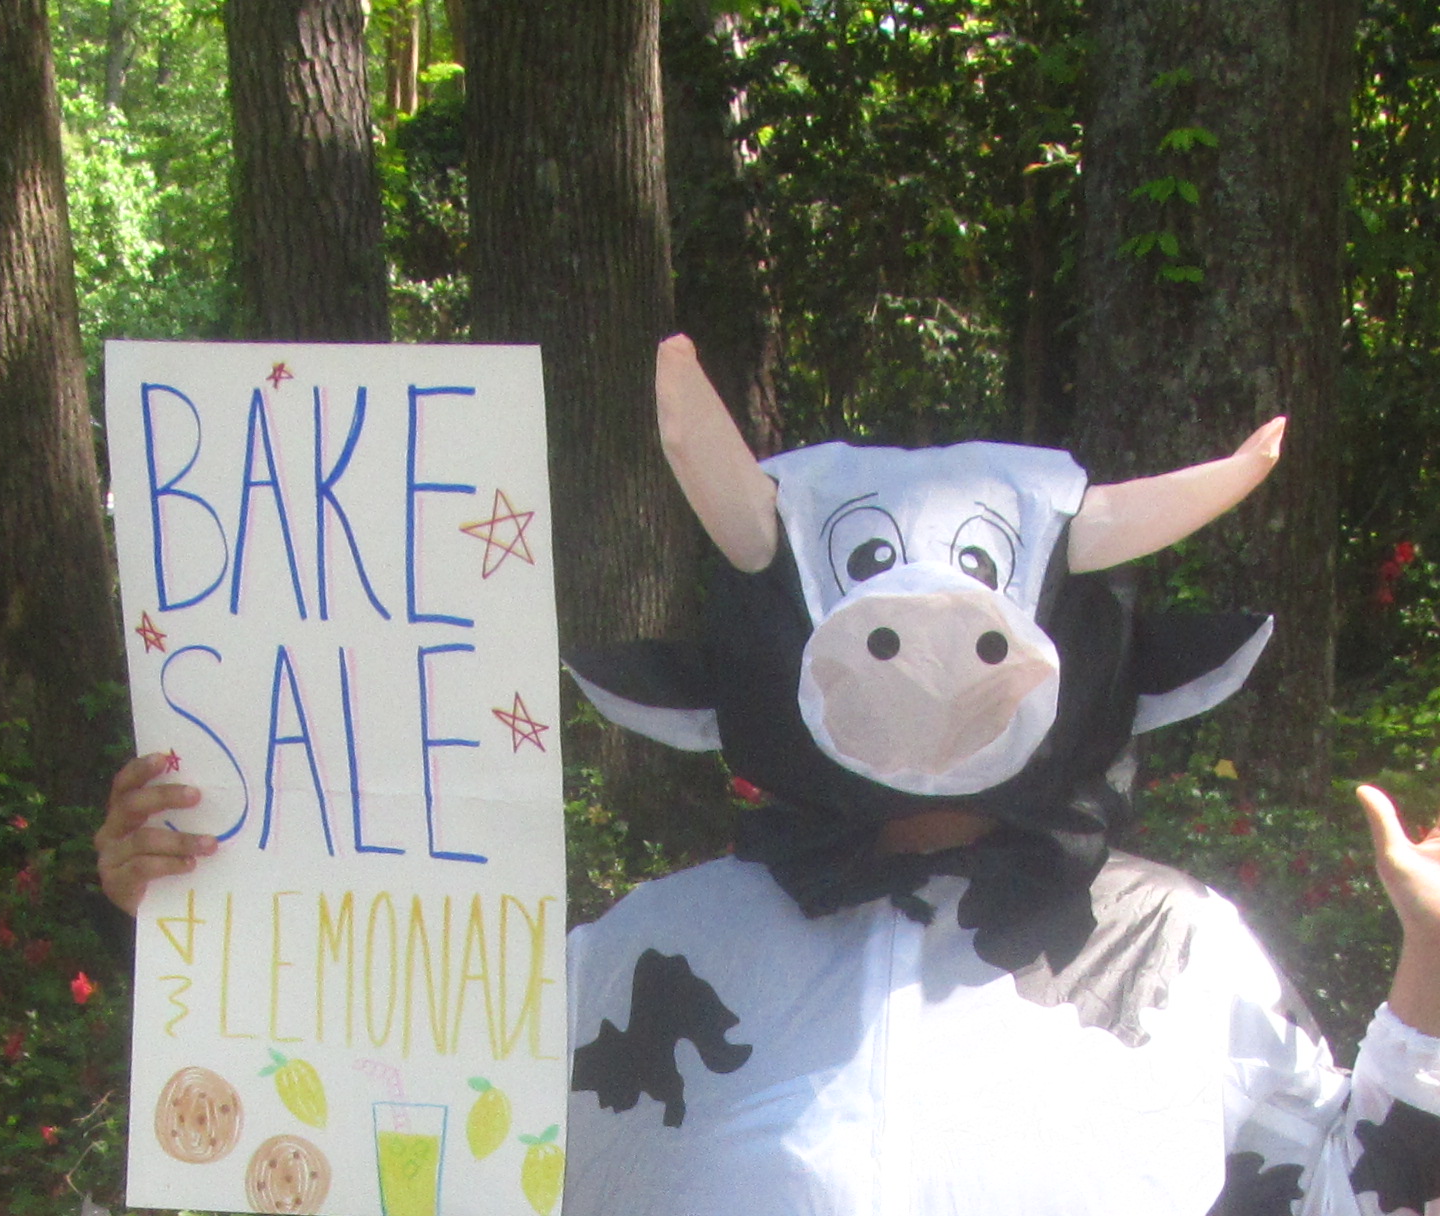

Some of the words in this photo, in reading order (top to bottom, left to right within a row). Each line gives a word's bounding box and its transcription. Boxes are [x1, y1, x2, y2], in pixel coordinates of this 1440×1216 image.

[141, 381, 477, 628] BAKE
[160, 643, 488, 864] SALE
[219, 890, 561, 1062] LEMONADE
